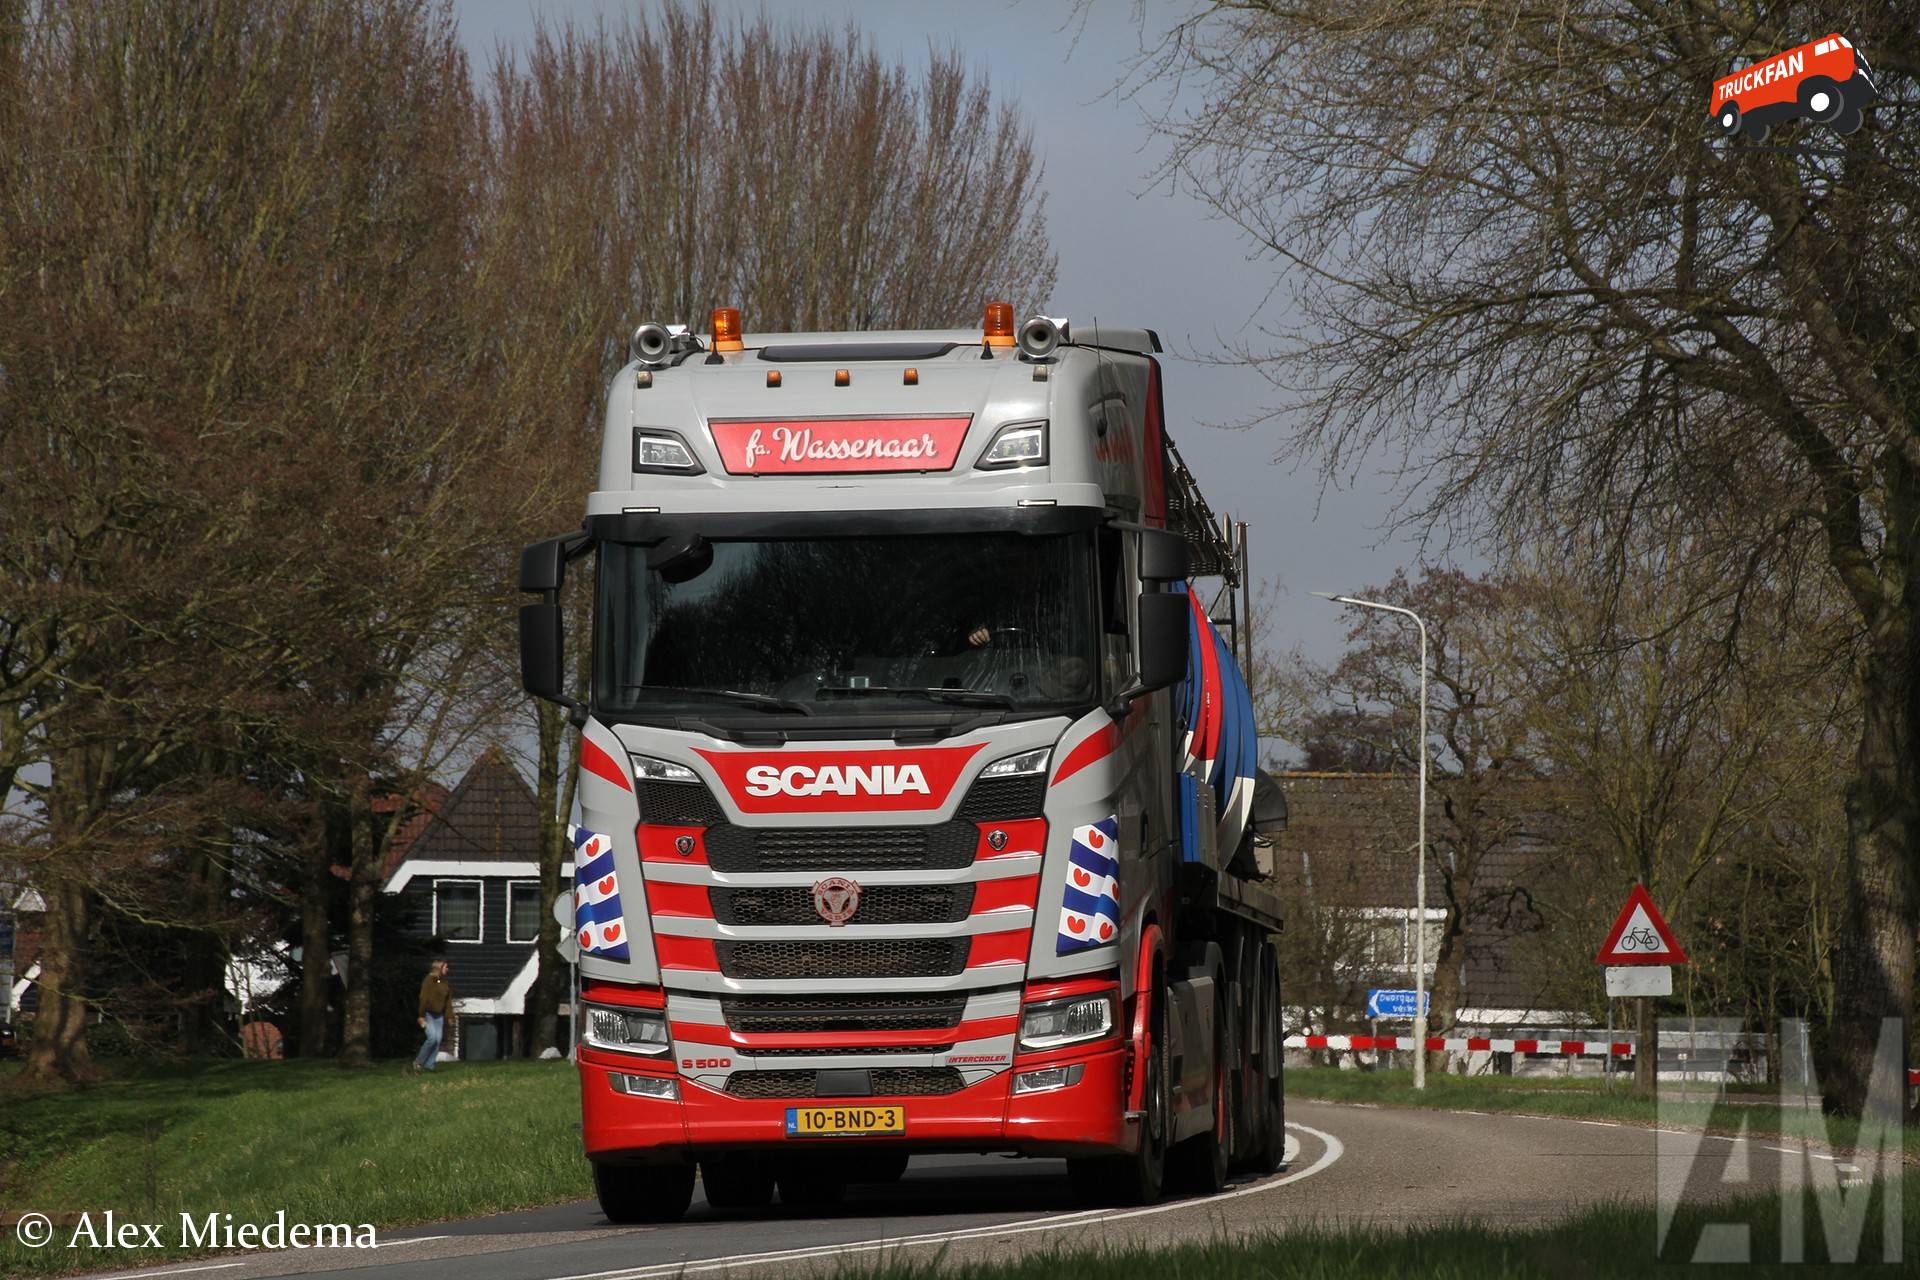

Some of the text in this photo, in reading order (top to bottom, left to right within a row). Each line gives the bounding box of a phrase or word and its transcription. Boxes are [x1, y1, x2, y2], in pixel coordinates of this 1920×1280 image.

[745, 426, 937, 468] fa. Wassenaar
[745, 765, 931, 797] SCANIA
[695, 1058, 732, 1068] 500
[948, 1055, 1007, 1063] INTERCOOLER
[804, 1110, 896, 1130] 10-BND-3
